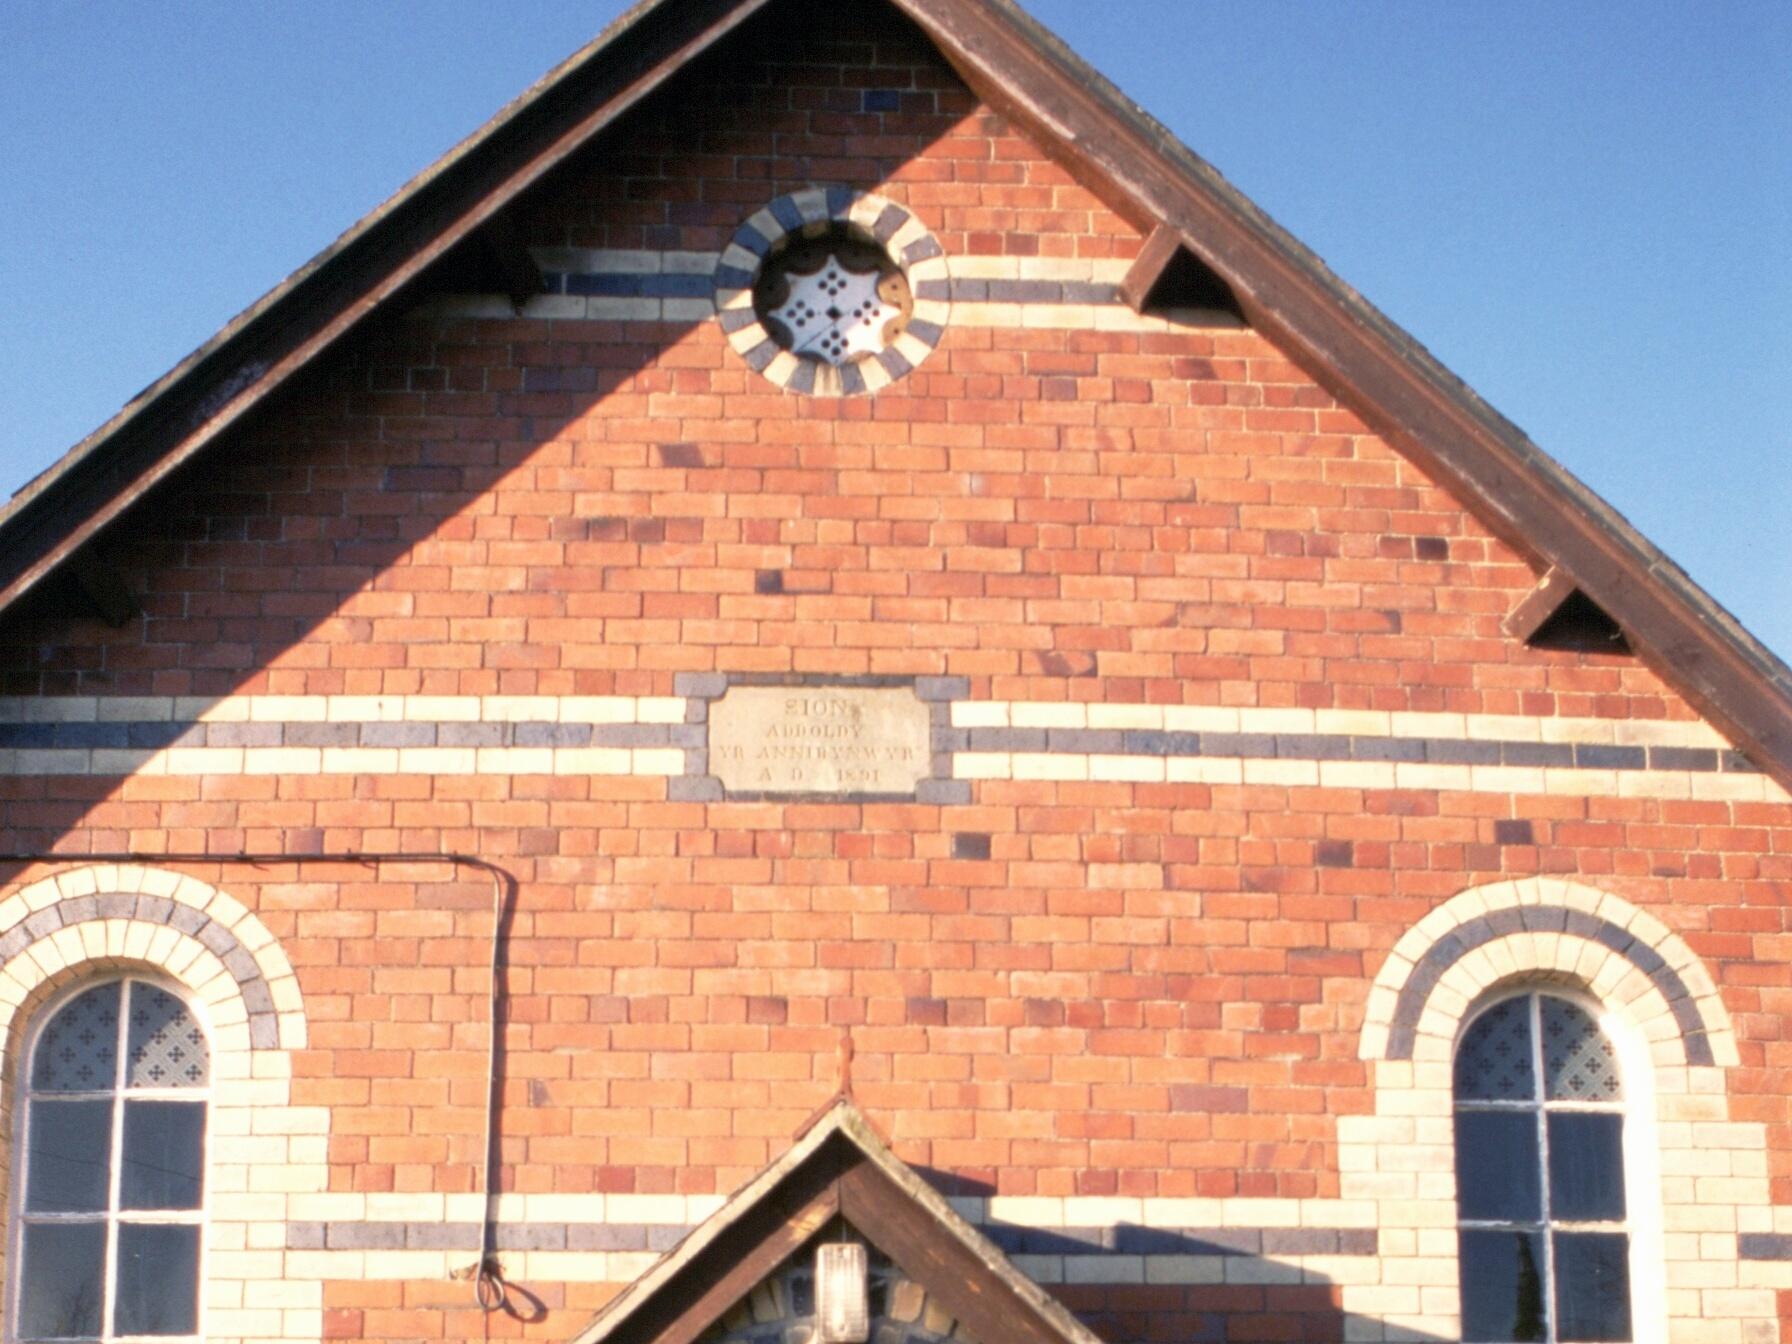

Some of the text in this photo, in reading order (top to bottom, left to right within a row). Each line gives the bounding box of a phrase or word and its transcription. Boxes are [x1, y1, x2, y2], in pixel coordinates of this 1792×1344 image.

[784, 698, 848, 717] SION
[766, 723, 865, 739] ADDOLDY
[719, 746, 744, 761] YR
